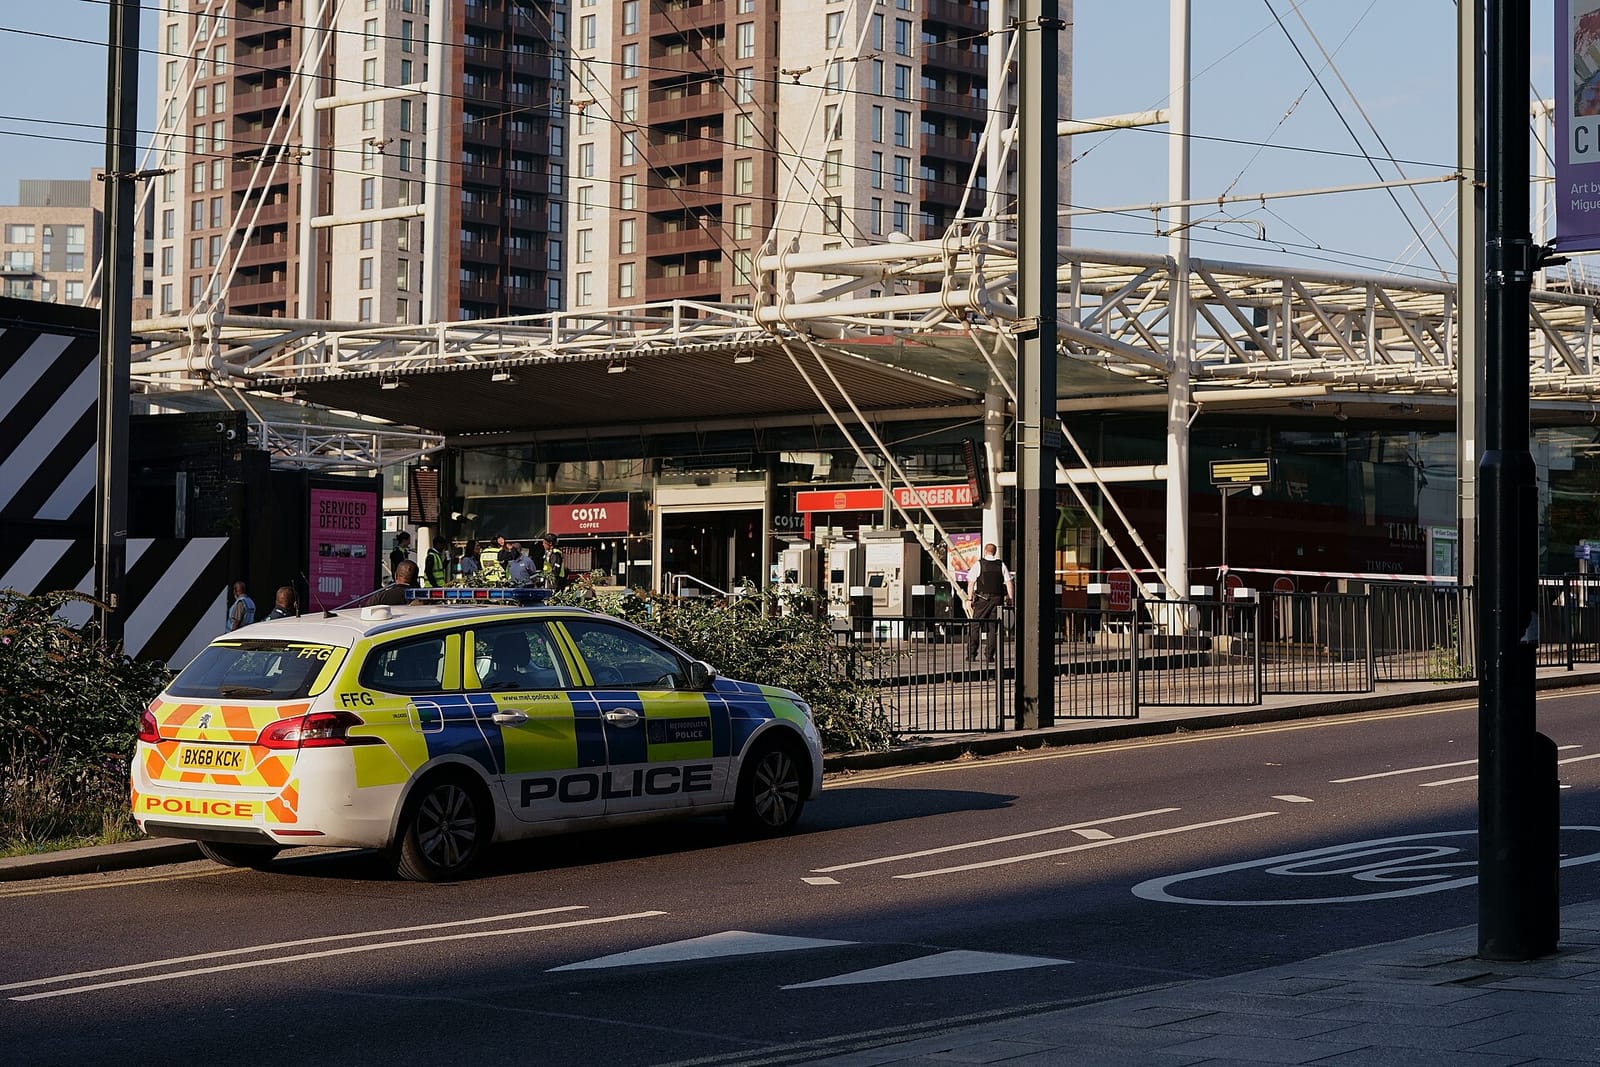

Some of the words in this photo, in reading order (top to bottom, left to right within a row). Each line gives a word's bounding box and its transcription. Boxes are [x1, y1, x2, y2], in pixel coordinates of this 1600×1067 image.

[1575, 125, 1600, 154] C
[1571, 183, 1588, 194] Art
[901, 489, 954, 505] BURGER
[956, 487, 973, 504] KI
[319, 500, 367, 516] SERVICED
[571, 507, 607, 521] COSTA
[319, 515, 361, 530] OFFICES
[1366, 560, 1403, 571] TIMPSON
[318, 576, 343, 597] amp
[1110, 582, 1130, 591] URGER
[297, 647, 332, 661] FFG
[340, 692, 375, 707] FFG
[502, 693, 560, 701] www.met.police.uk
[669, 720, 708, 729] METROPOLITAN
[675, 730, 704, 739] POLICE
[183, 749, 213, 766] BX68
[215, 750, 241, 767] KCK
[520, 764, 713, 809] POLICE
[146, 797, 253, 817] POLICE
